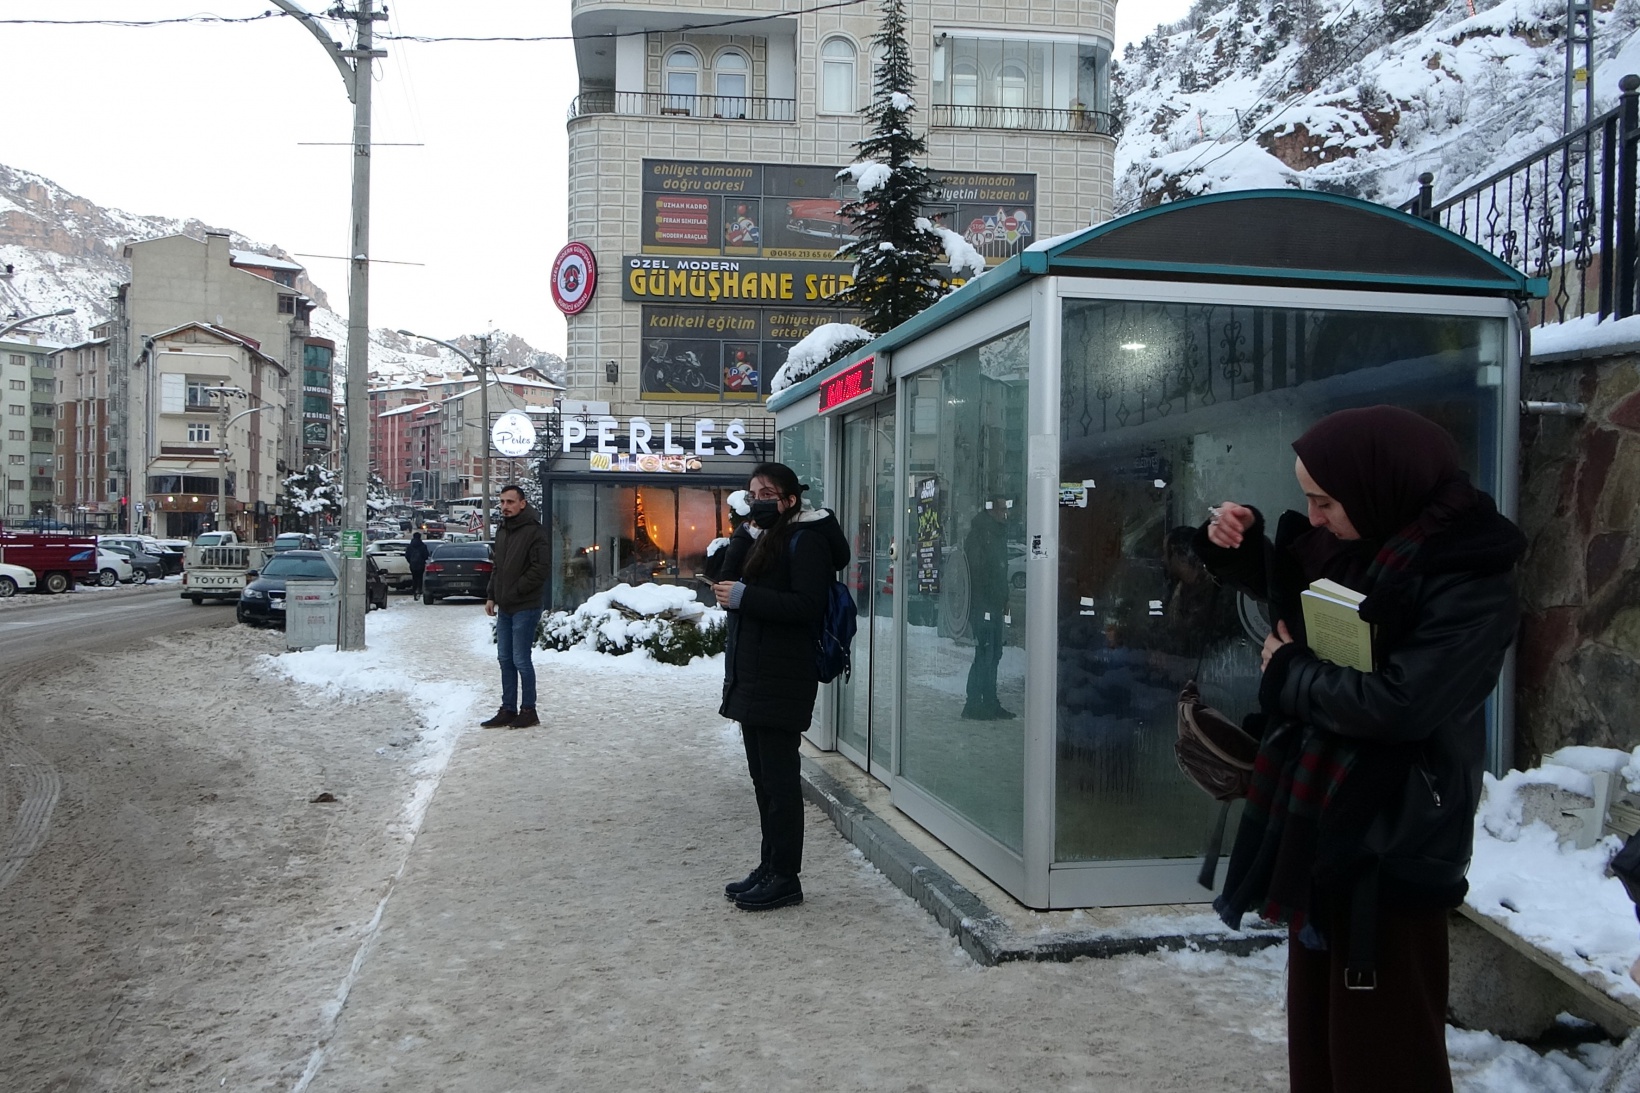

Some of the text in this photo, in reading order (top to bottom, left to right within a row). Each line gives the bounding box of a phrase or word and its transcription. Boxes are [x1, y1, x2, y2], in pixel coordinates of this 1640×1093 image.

[653, 164, 753, 177] ehliyet almanın
[662, 179, 745, 191] doğru adresi
[968, 175, 1015, 186] almadan
[980, 189, 1016, 200] bizden
[1018, 190, 1030, 200] al
[798, 250, 811, 258] 213
[630, 259, 740, 271] ÖZEL MODERN
[629, 269, 793, 302] GÜMÜŞHANE
[649, 314, 755, 331] kaliteli eğitim
[496, 431, 531, 445] Perles
[562, 420, 746, 456] PERLES
[194, 576, 239, 584] TOYOTA
